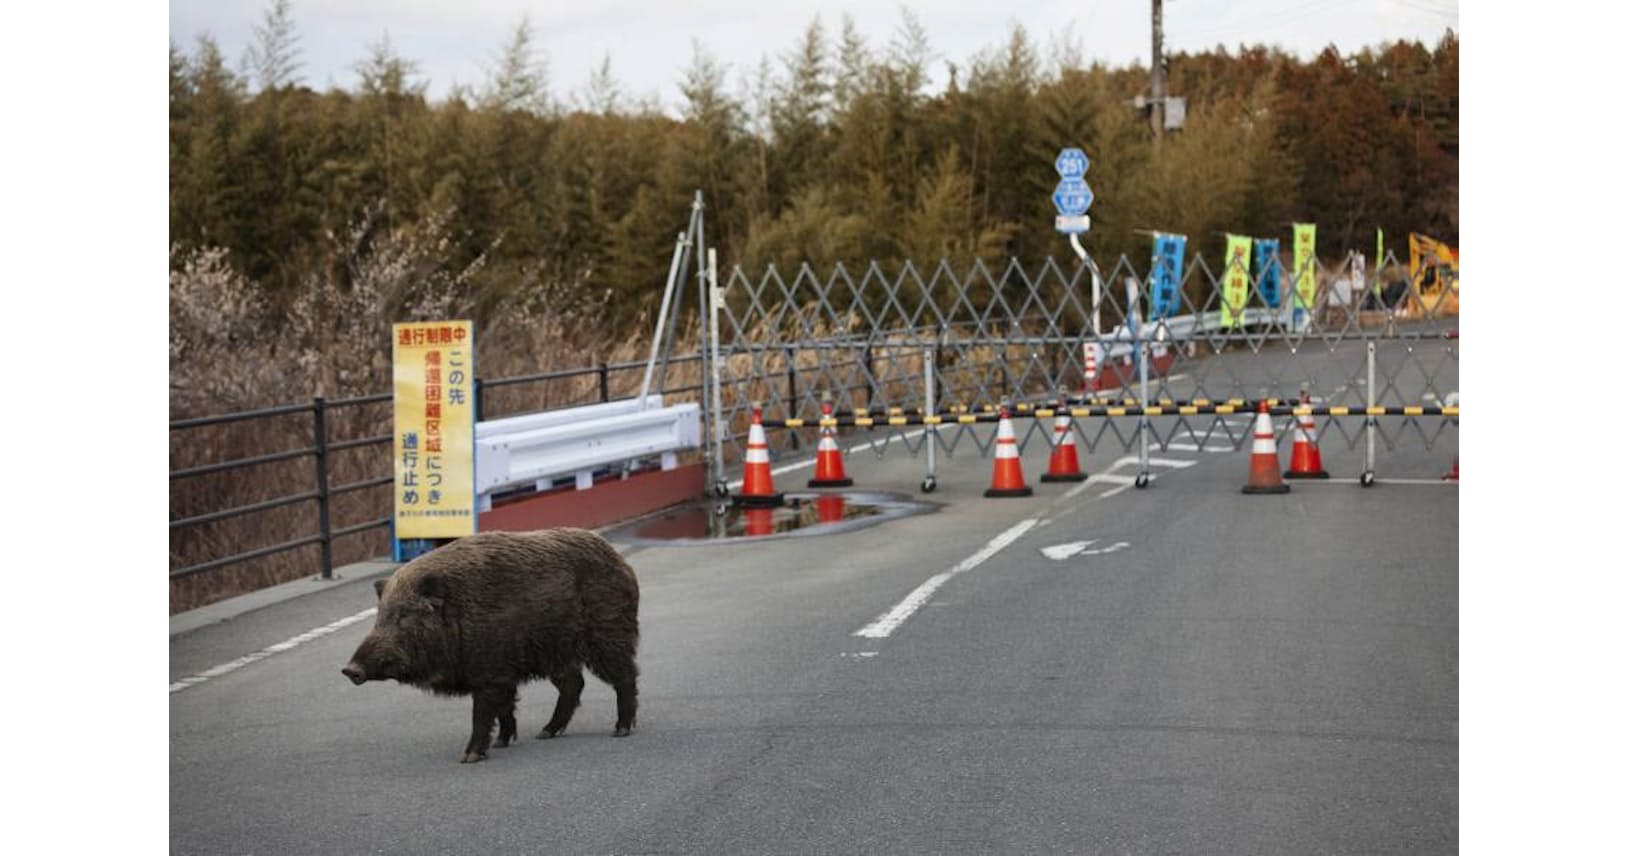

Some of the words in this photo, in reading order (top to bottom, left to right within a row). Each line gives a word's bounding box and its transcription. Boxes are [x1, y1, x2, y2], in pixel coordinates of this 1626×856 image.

[1062, 158, 1083, 174] 251
[398, 326, 466, 345] 通行制限中
[449, 351, 465, 405] この先
[425, 350, 441, 504] 帰還困難区域につき
[402, 432, 418, 504] 通行止め
